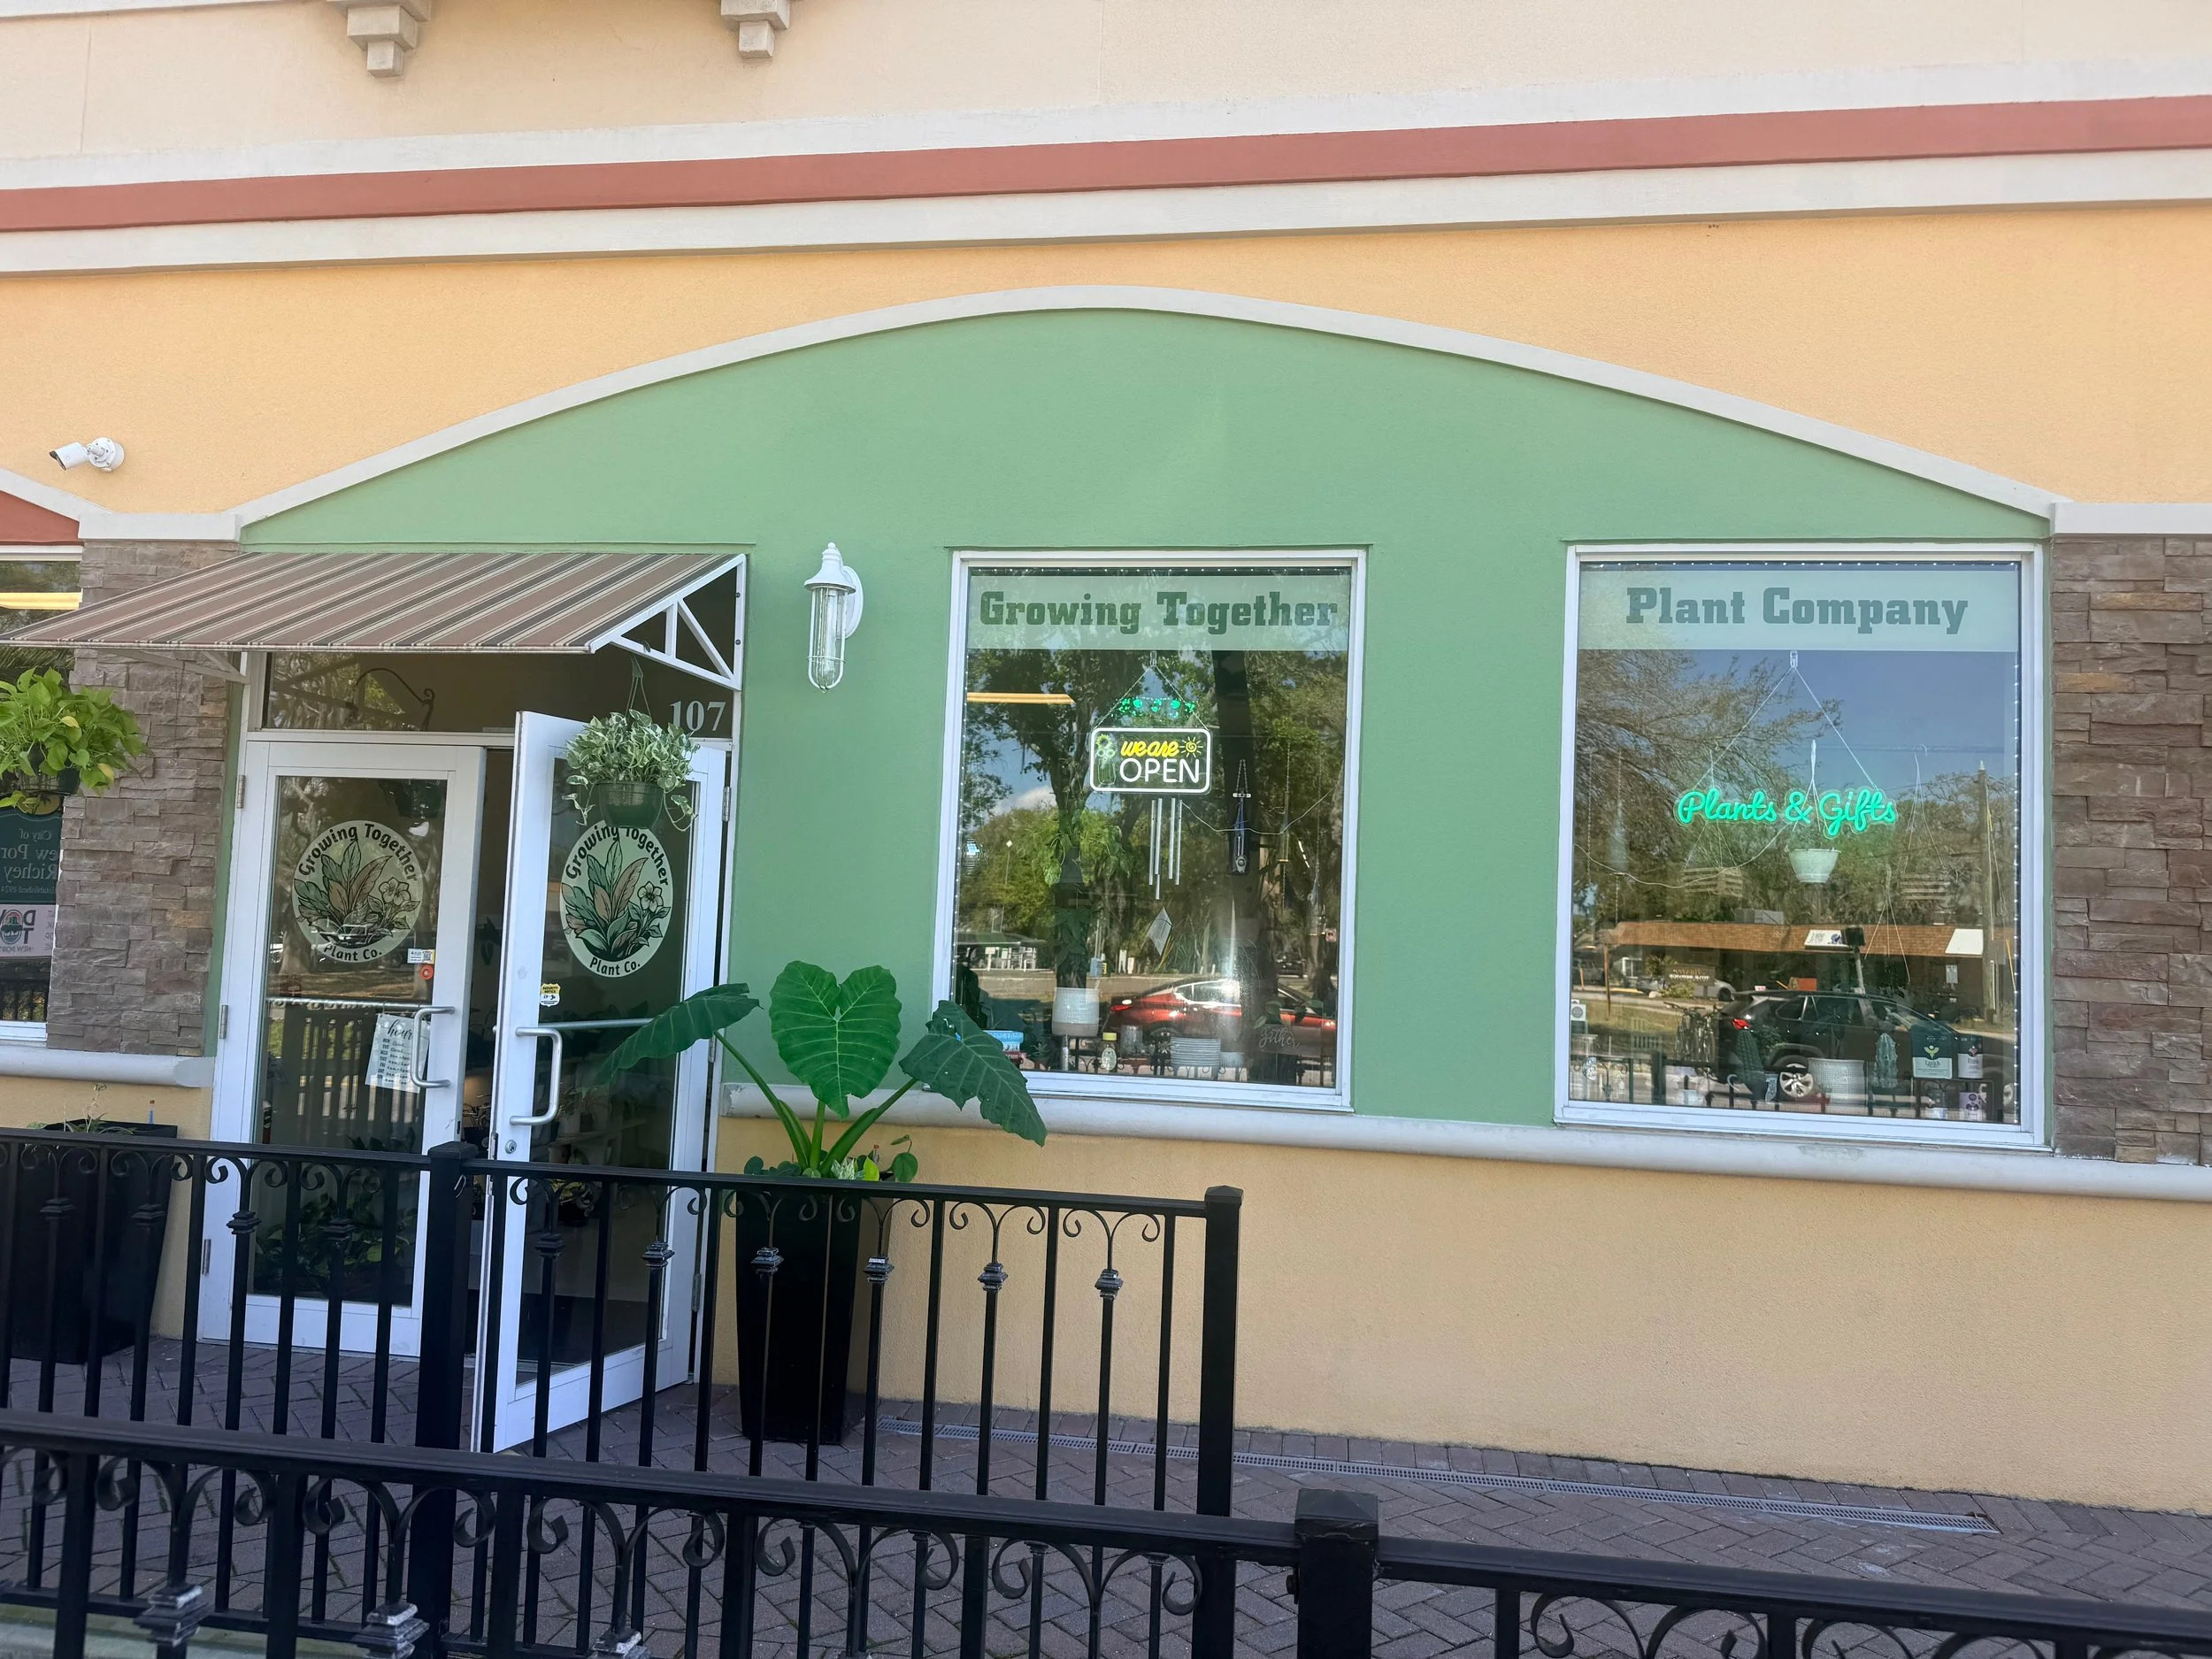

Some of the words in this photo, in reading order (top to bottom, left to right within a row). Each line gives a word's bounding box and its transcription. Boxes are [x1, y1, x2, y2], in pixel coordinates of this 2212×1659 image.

[979, 591, 1142, 634] Growing
[1156, 591, 1338, 634] Together
[1626, 587, 1745, 625] Plant
[1763, 587, 1969, 635] Company
[670, 700, 726, 732] 107
[1120, 741, 1148, 757] we
[1147, 740, 1180, 757] are
[1119, 757, 1200, 784] OPEN
[1678, 787, 1778, 824] Plants
[1785, 791, 1813, 824] &
[1819, 788, 1896, 836] Gifts
[298, 826, 358, 876] Growing
[365, 823, 418, 881] Together
[565, 825, 619, 879] Growing
[324, 945, 358, 962] Plant
[363, 949, 382, 961] Co.
[590, 956, 620, 976] Plant
[624, 960, 641, 974] Co.
[388, 1018, 413, 1041] hour
